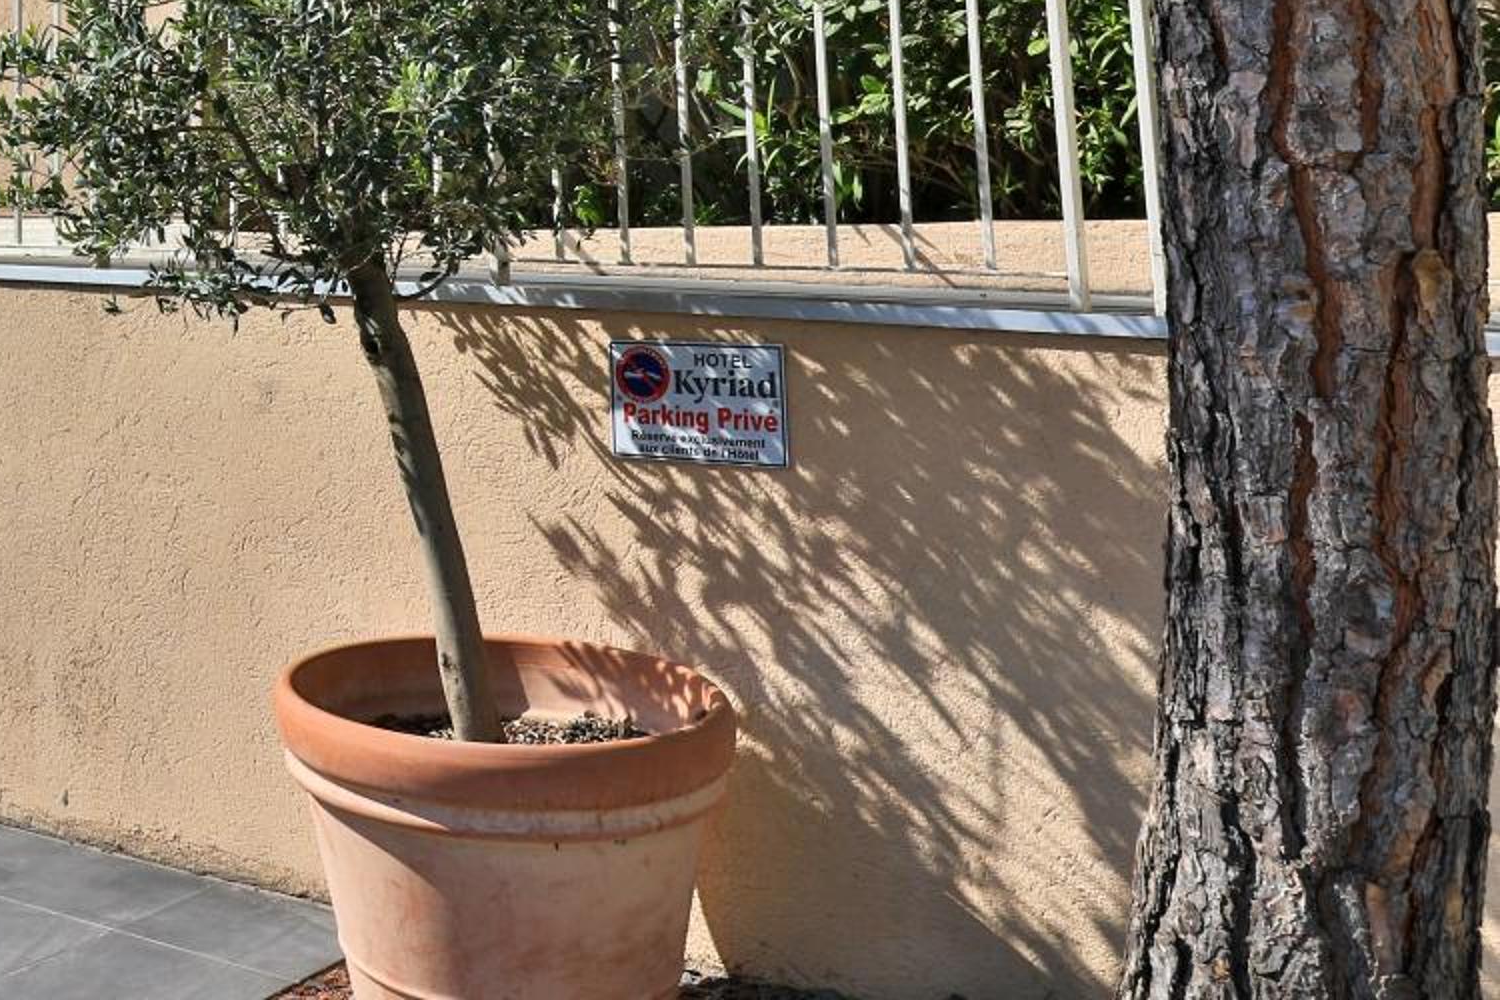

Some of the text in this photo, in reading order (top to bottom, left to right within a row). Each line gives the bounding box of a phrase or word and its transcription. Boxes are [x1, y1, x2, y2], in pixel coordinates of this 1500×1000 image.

[694, 354, 752, 369] HOTEL
[674, 370, 777, 404] Kyriad
[623, 402, 778, 434] Parking Privé
[703, 447, 718, 457] de
